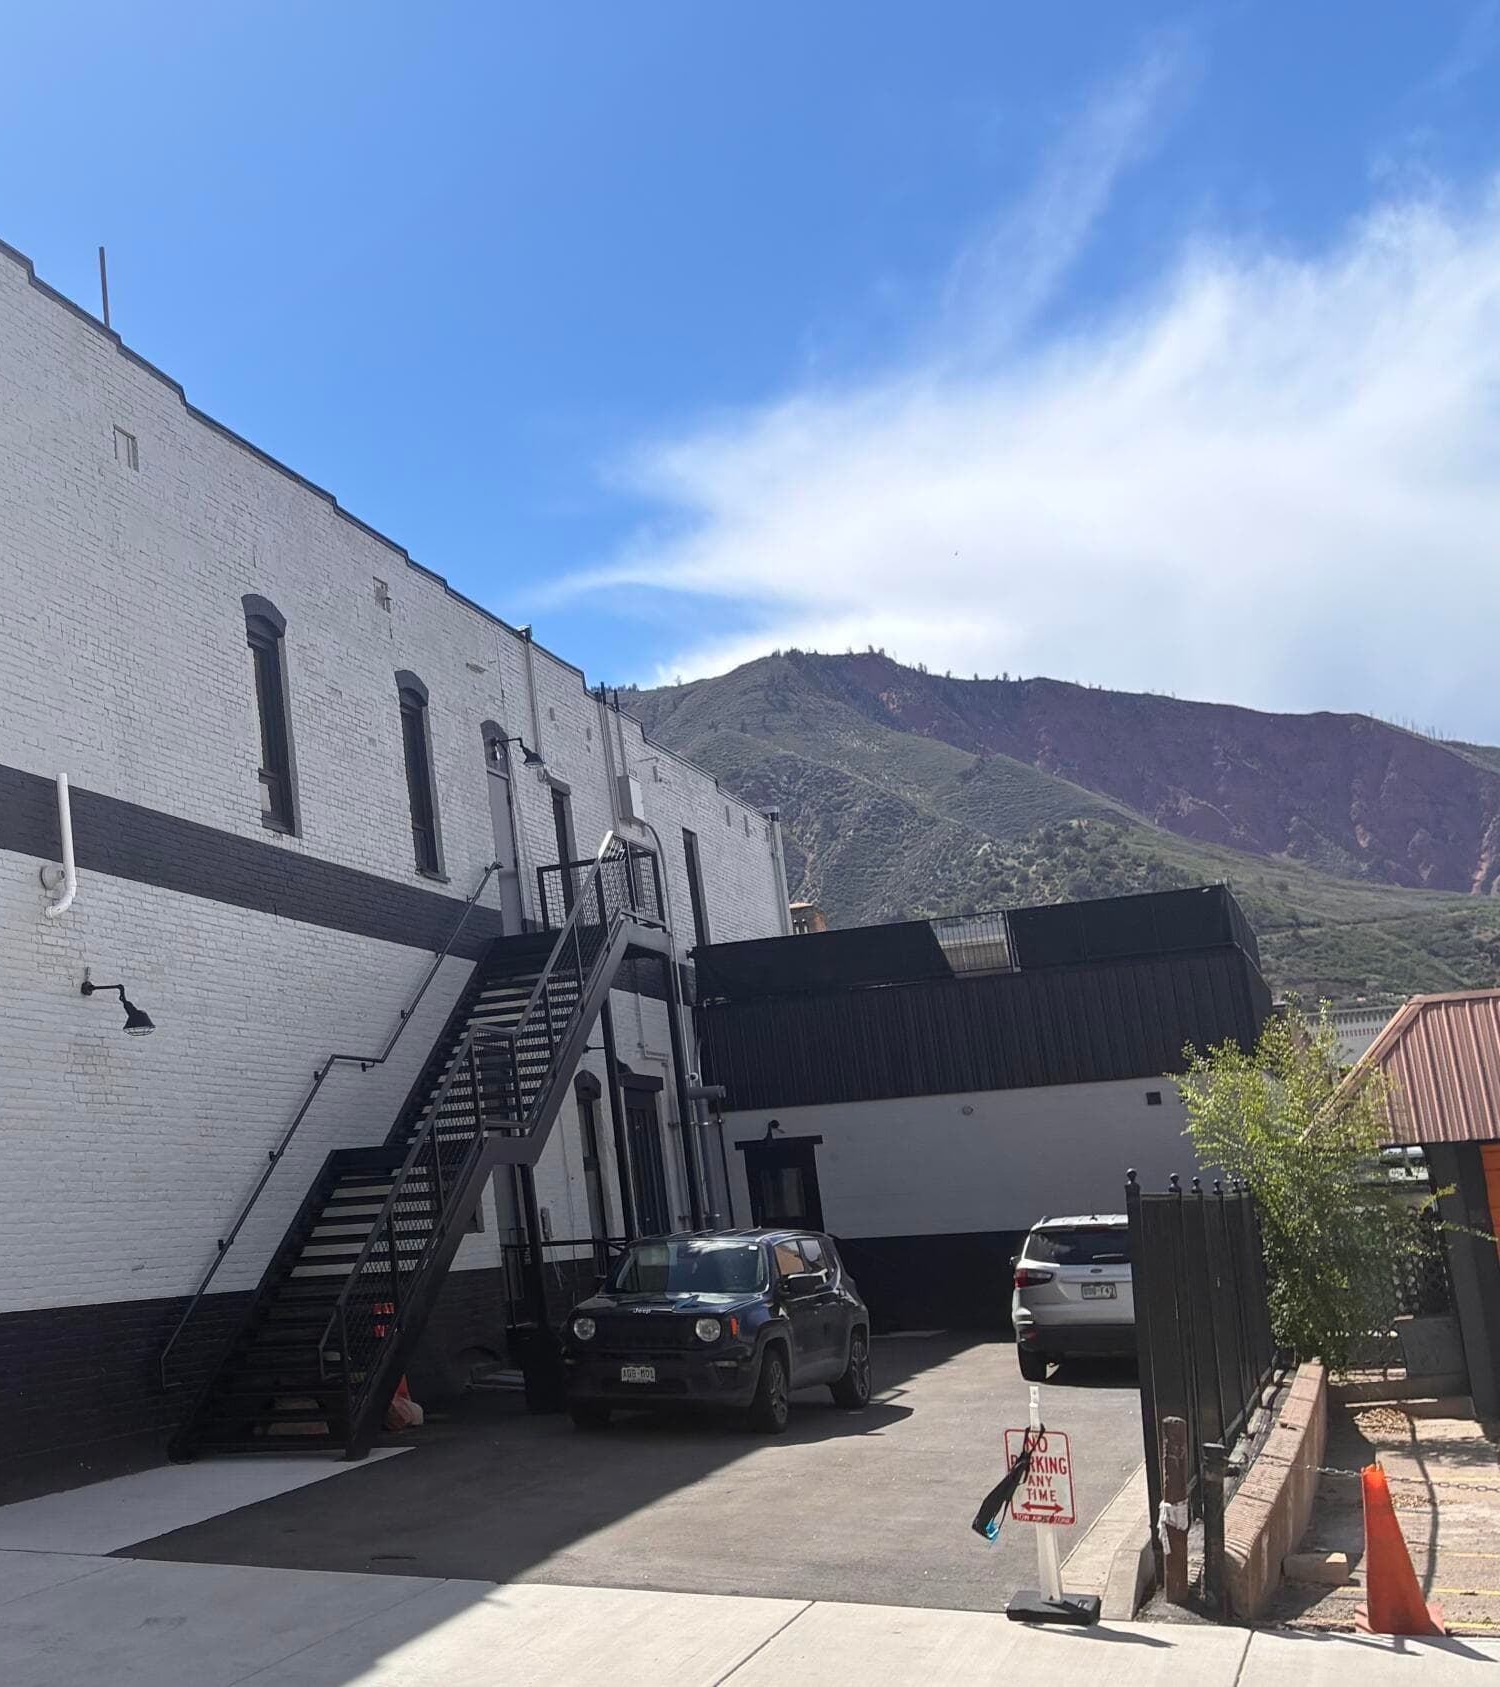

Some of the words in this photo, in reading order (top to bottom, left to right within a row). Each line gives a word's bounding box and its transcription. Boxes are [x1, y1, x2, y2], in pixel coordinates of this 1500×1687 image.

[1025, 1434, 1048, 1453] NO
[1010, 1454, 1067, 1475] PRKING
[1027, 1475, 1053, 1488] ANY
[1026, 1488, 1057, 1502] TIME
